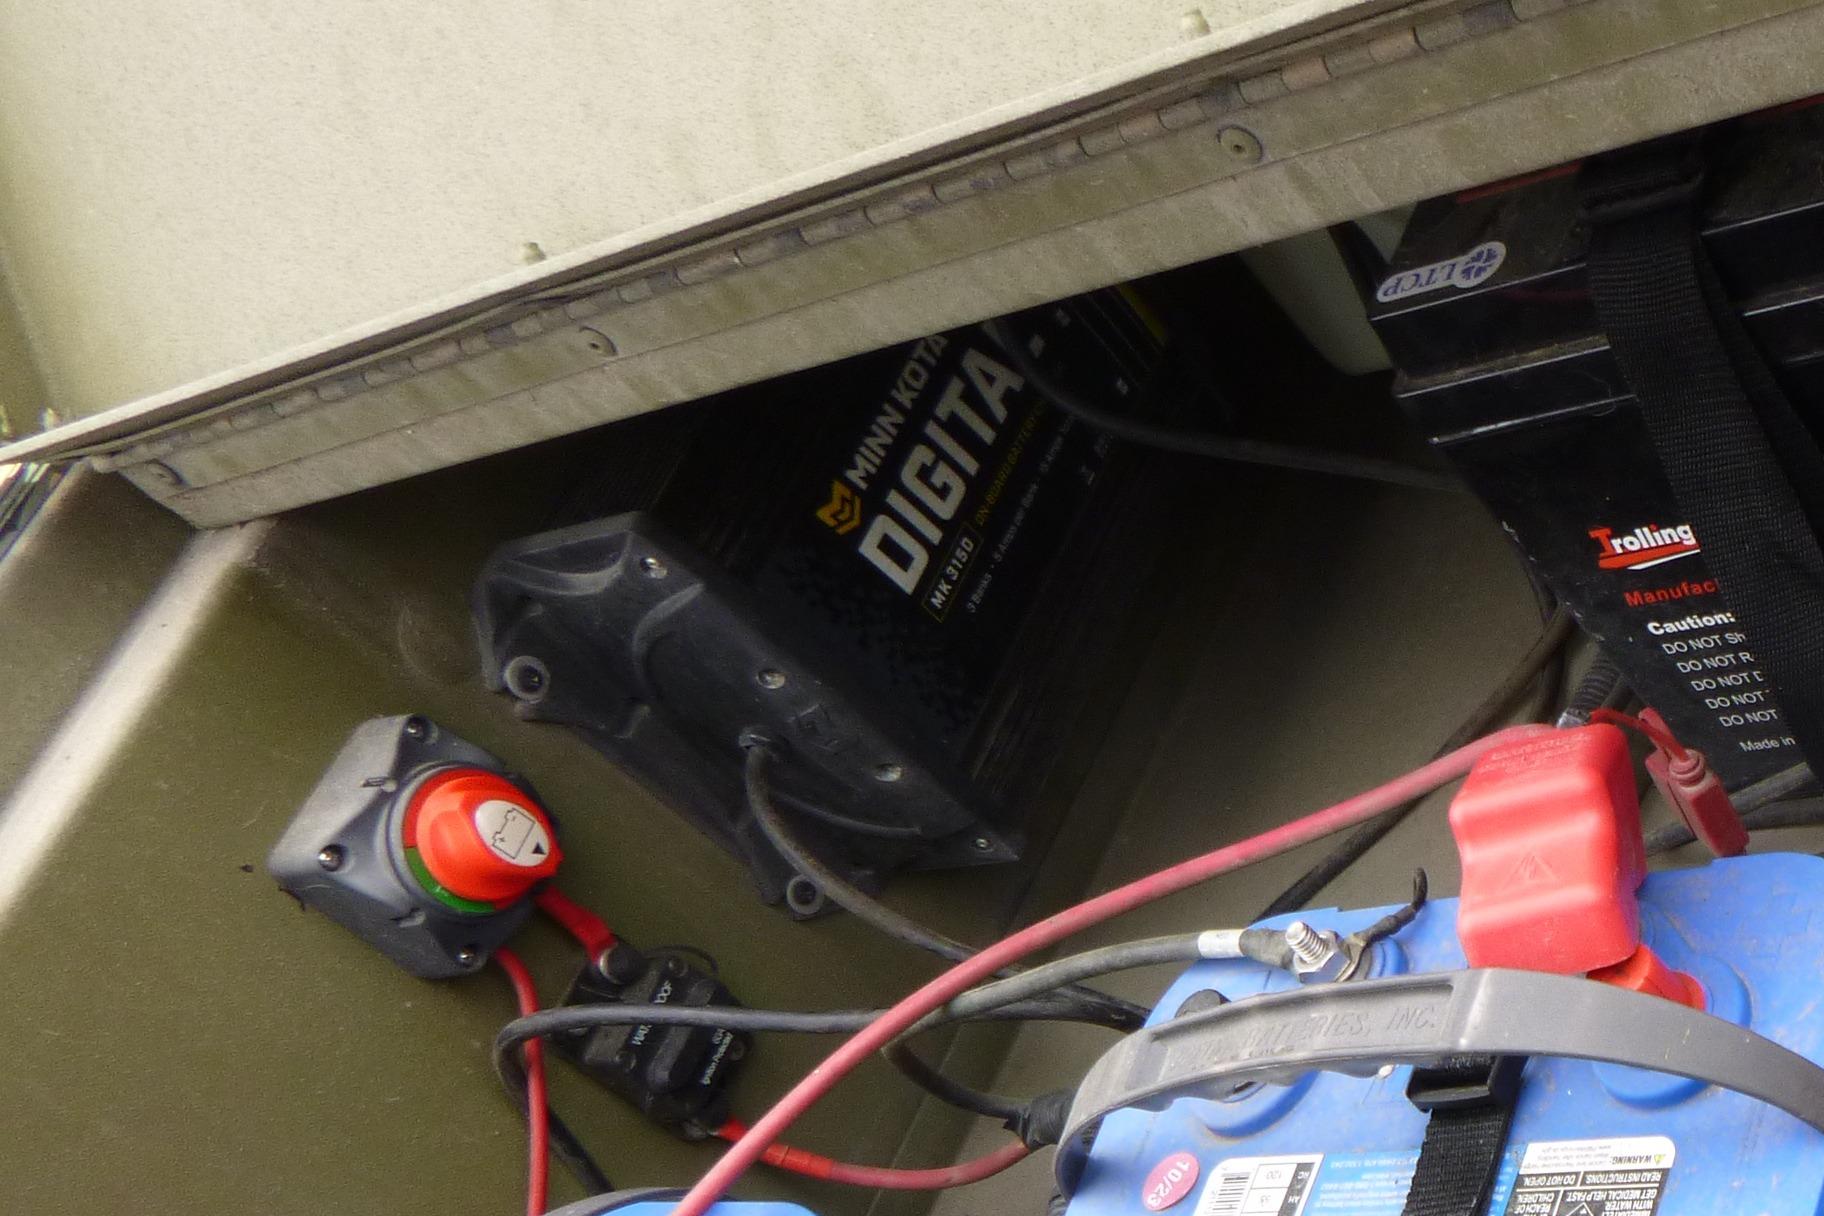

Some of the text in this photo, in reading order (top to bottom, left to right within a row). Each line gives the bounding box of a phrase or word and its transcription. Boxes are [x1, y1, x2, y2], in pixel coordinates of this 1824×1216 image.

[1382, 261, 1457, 296] LTCP
[844, 334, 948, 490] MINN KOTA
[858, 345, 1026, 595] DIGITA
[1589, 524, 1696, 553] Trolling
[930, 537, 974, 609] MK 3150
[1624, 579, 1718, 607] Manufac
[1647, 611, 1736, 635] Caution:
[1662, 641, 1688, 655] DO
[1691, 635, 1721, 651] NOT
[1677, 660, 1702, 673] DO
[1705, 654, 1736, 669] NOT
[1691, 673, 1750, 692] DO NOT
[1705, 691, 1765, 710] DO NOT
[1719, 709, 1778, 727] DO NOT
[1740, 736, 1796, 752] Made in
[1610, 1154, 1651, 1164] WARNING:
[1146, 1160, 1190, 1206] 10/23
[1523, 1175, 1574, 1185] DO NOT OPEN.
[1585, 1171, 1661, 1182] READ INSTRUCTIONS.
[1517, 1192, 1554, 1201] CHILDREN.
[1566, 1189, 1656, 1200] GET MEDICAL HELP FAST.
[1604, 1199, 1652, 1209] WITH WATER.
[1514, 1204, 1550, 1212] REACH OF
